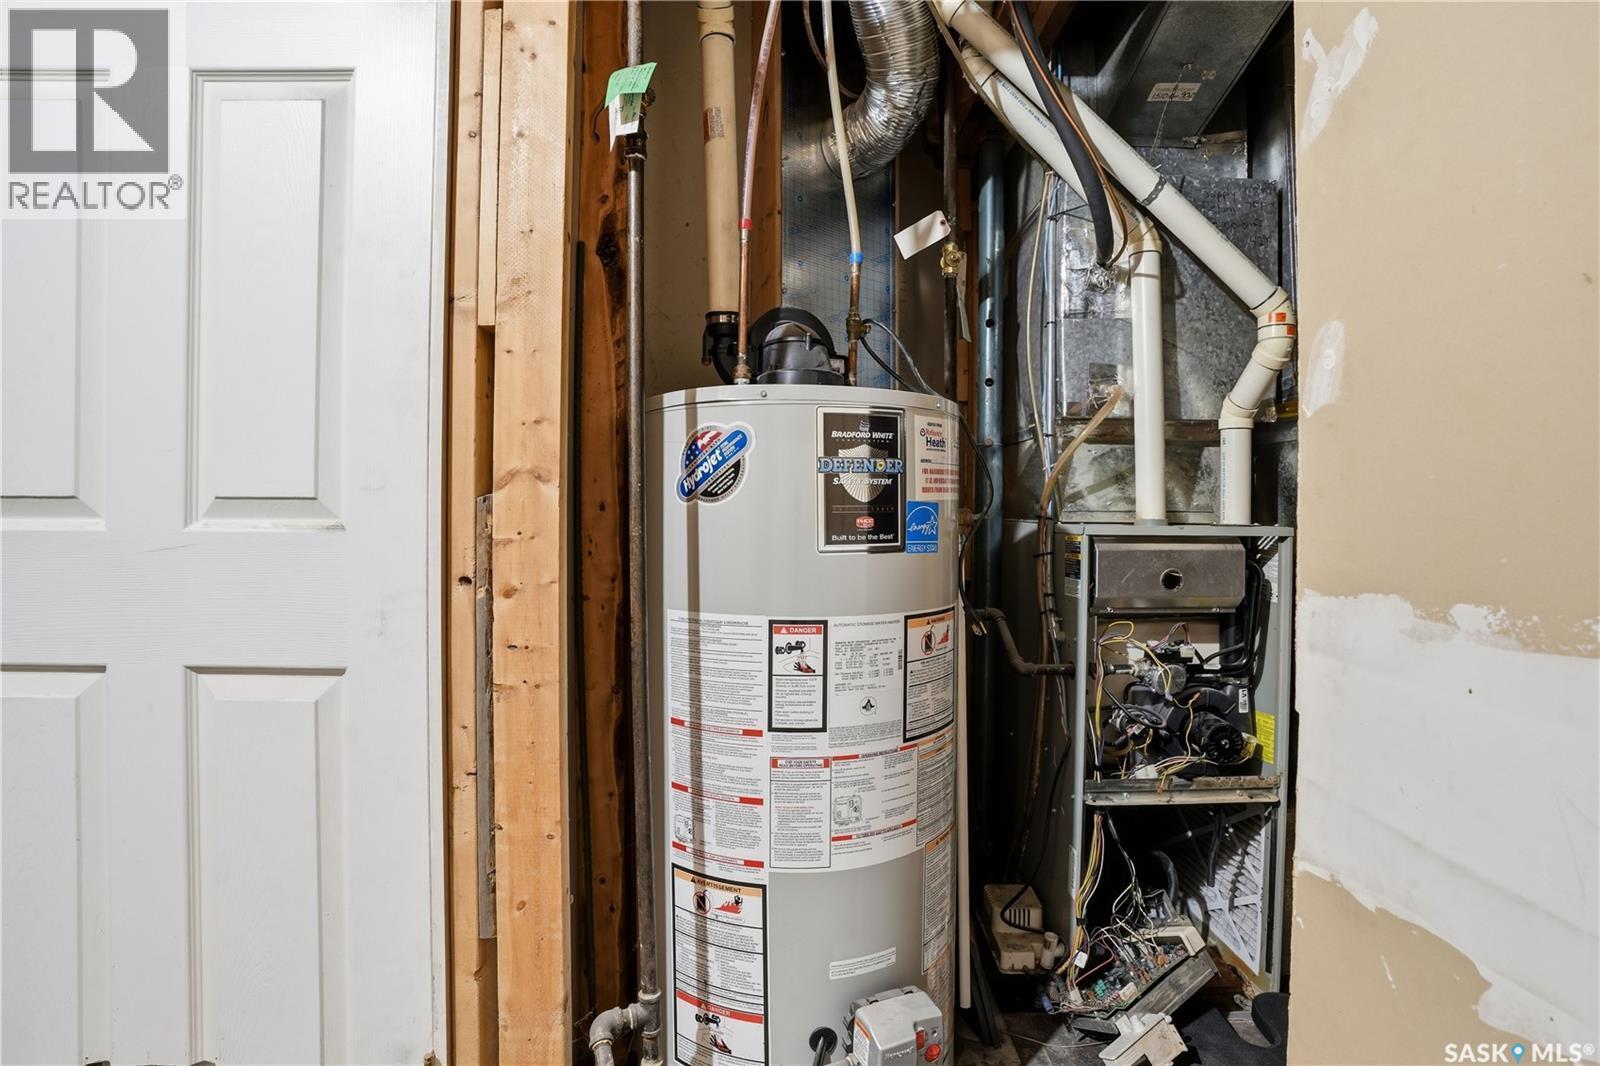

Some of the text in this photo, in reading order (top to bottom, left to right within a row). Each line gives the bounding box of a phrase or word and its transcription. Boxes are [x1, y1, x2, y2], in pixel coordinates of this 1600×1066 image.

[831, 430, 894, 440] BRADFORD WHITE
[681, 444, 724, 493] Hydrojet
[818, 457, 903, 473] DEFENDER
[865, 478, 893, 486] SYSTEM
